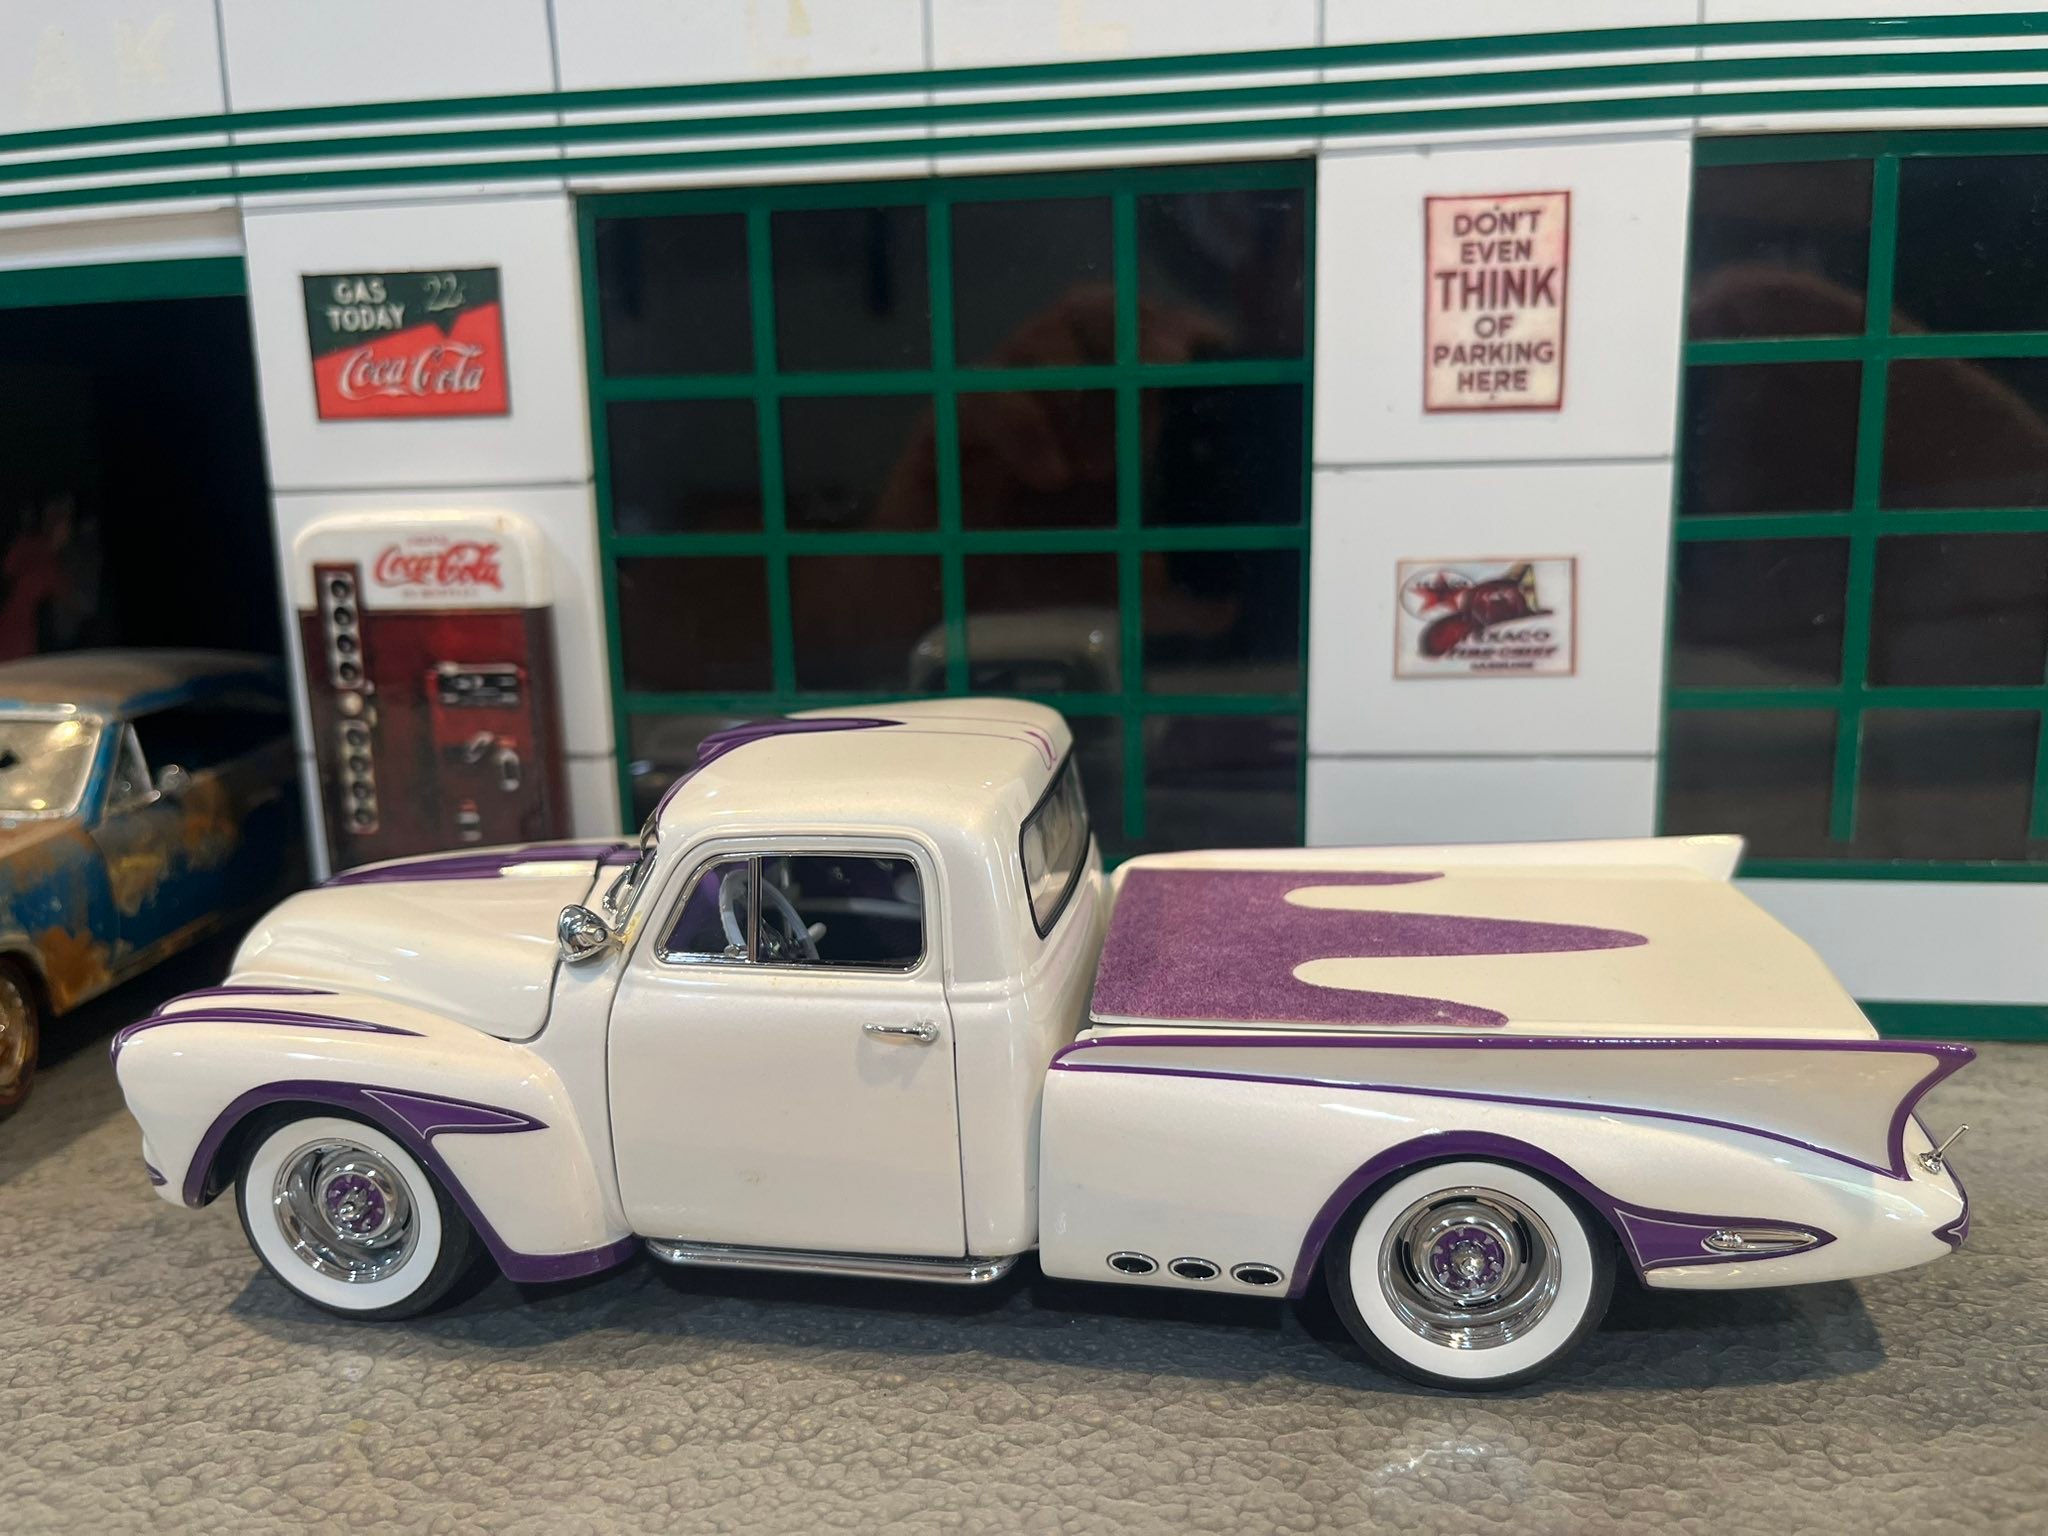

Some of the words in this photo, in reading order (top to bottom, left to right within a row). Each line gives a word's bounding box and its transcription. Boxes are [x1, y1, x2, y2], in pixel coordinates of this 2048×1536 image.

[1453, 210, 1542, 236] DON'T
[1460, 240, 1532, 264] EVEN
[332, 277, 388, 304] GAS
[1434, 268, 1557, 311] THINK
[326, 303, 406, 332] TODAY
[1474, 315, 1515, 339] OF
[1432, 341, 1555, 366] PARKING
[1457, 369, 1529, 393] HERE
